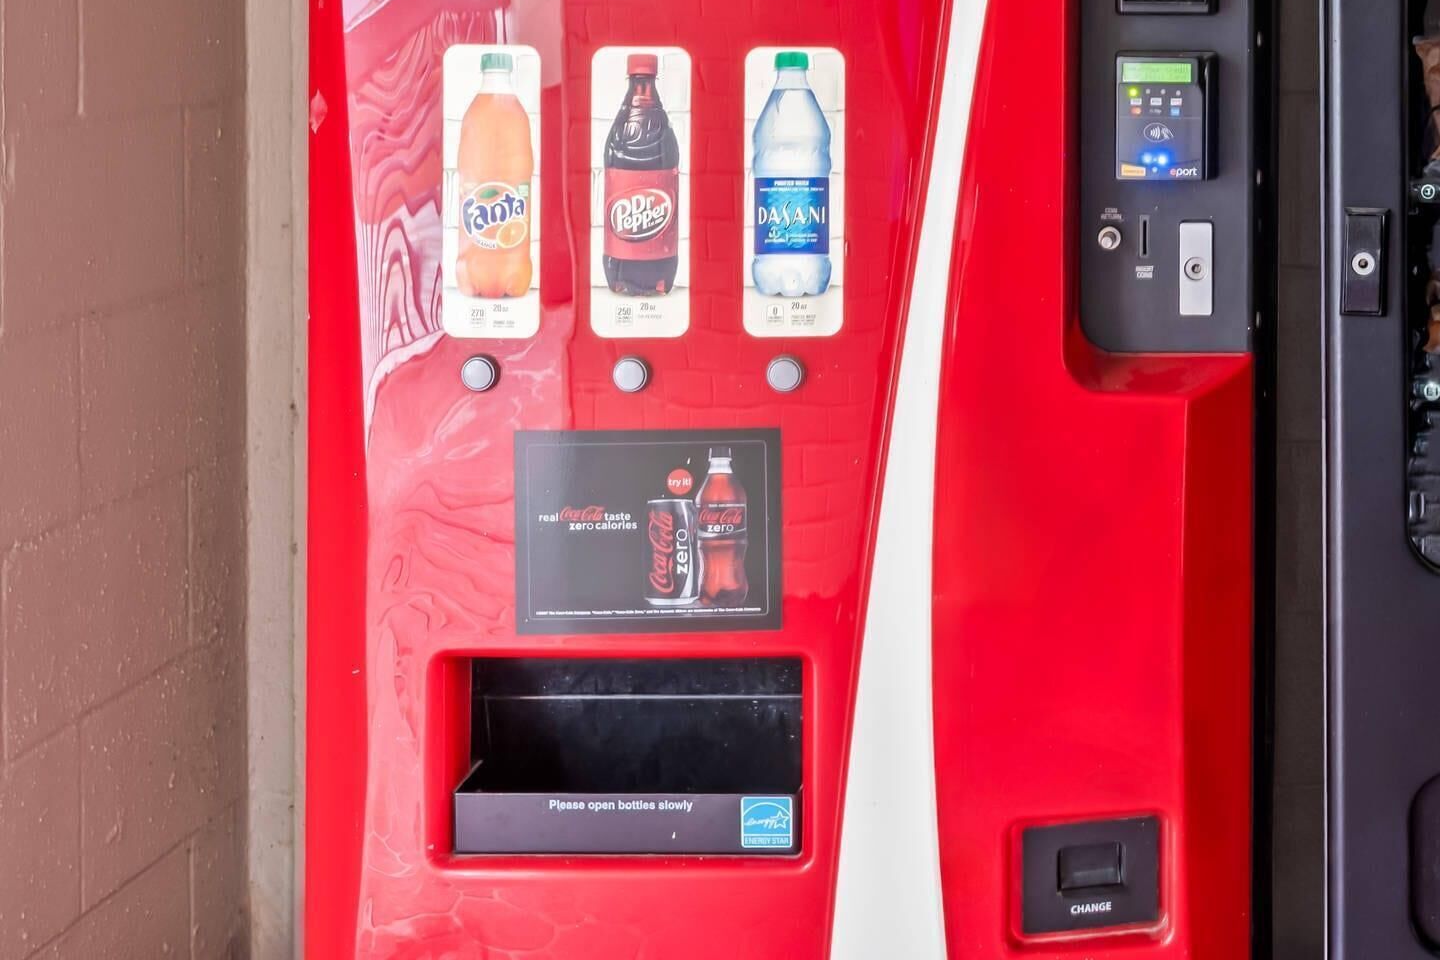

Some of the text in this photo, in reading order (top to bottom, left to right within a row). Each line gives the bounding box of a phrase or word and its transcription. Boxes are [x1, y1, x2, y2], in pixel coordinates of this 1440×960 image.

[631, 193, 655, 210] Dr
[462, 192, 526, 235] Fanta
[617, 201, 668, 235] Pepper
[758, 202, 826, 229] DASANI
[668, 477, 682, 488] try
[538, 512, 559, 523] real
[604, 512, 631, 522] taste
[569, 520, 638, 531] zero calories
[707, 524, 734, 533] zero
[676, 528, 688, 575] zero
[549, 799, 693, 813] Please open bottles slowly
[1070, 901, 1112, 915] CHANGE
